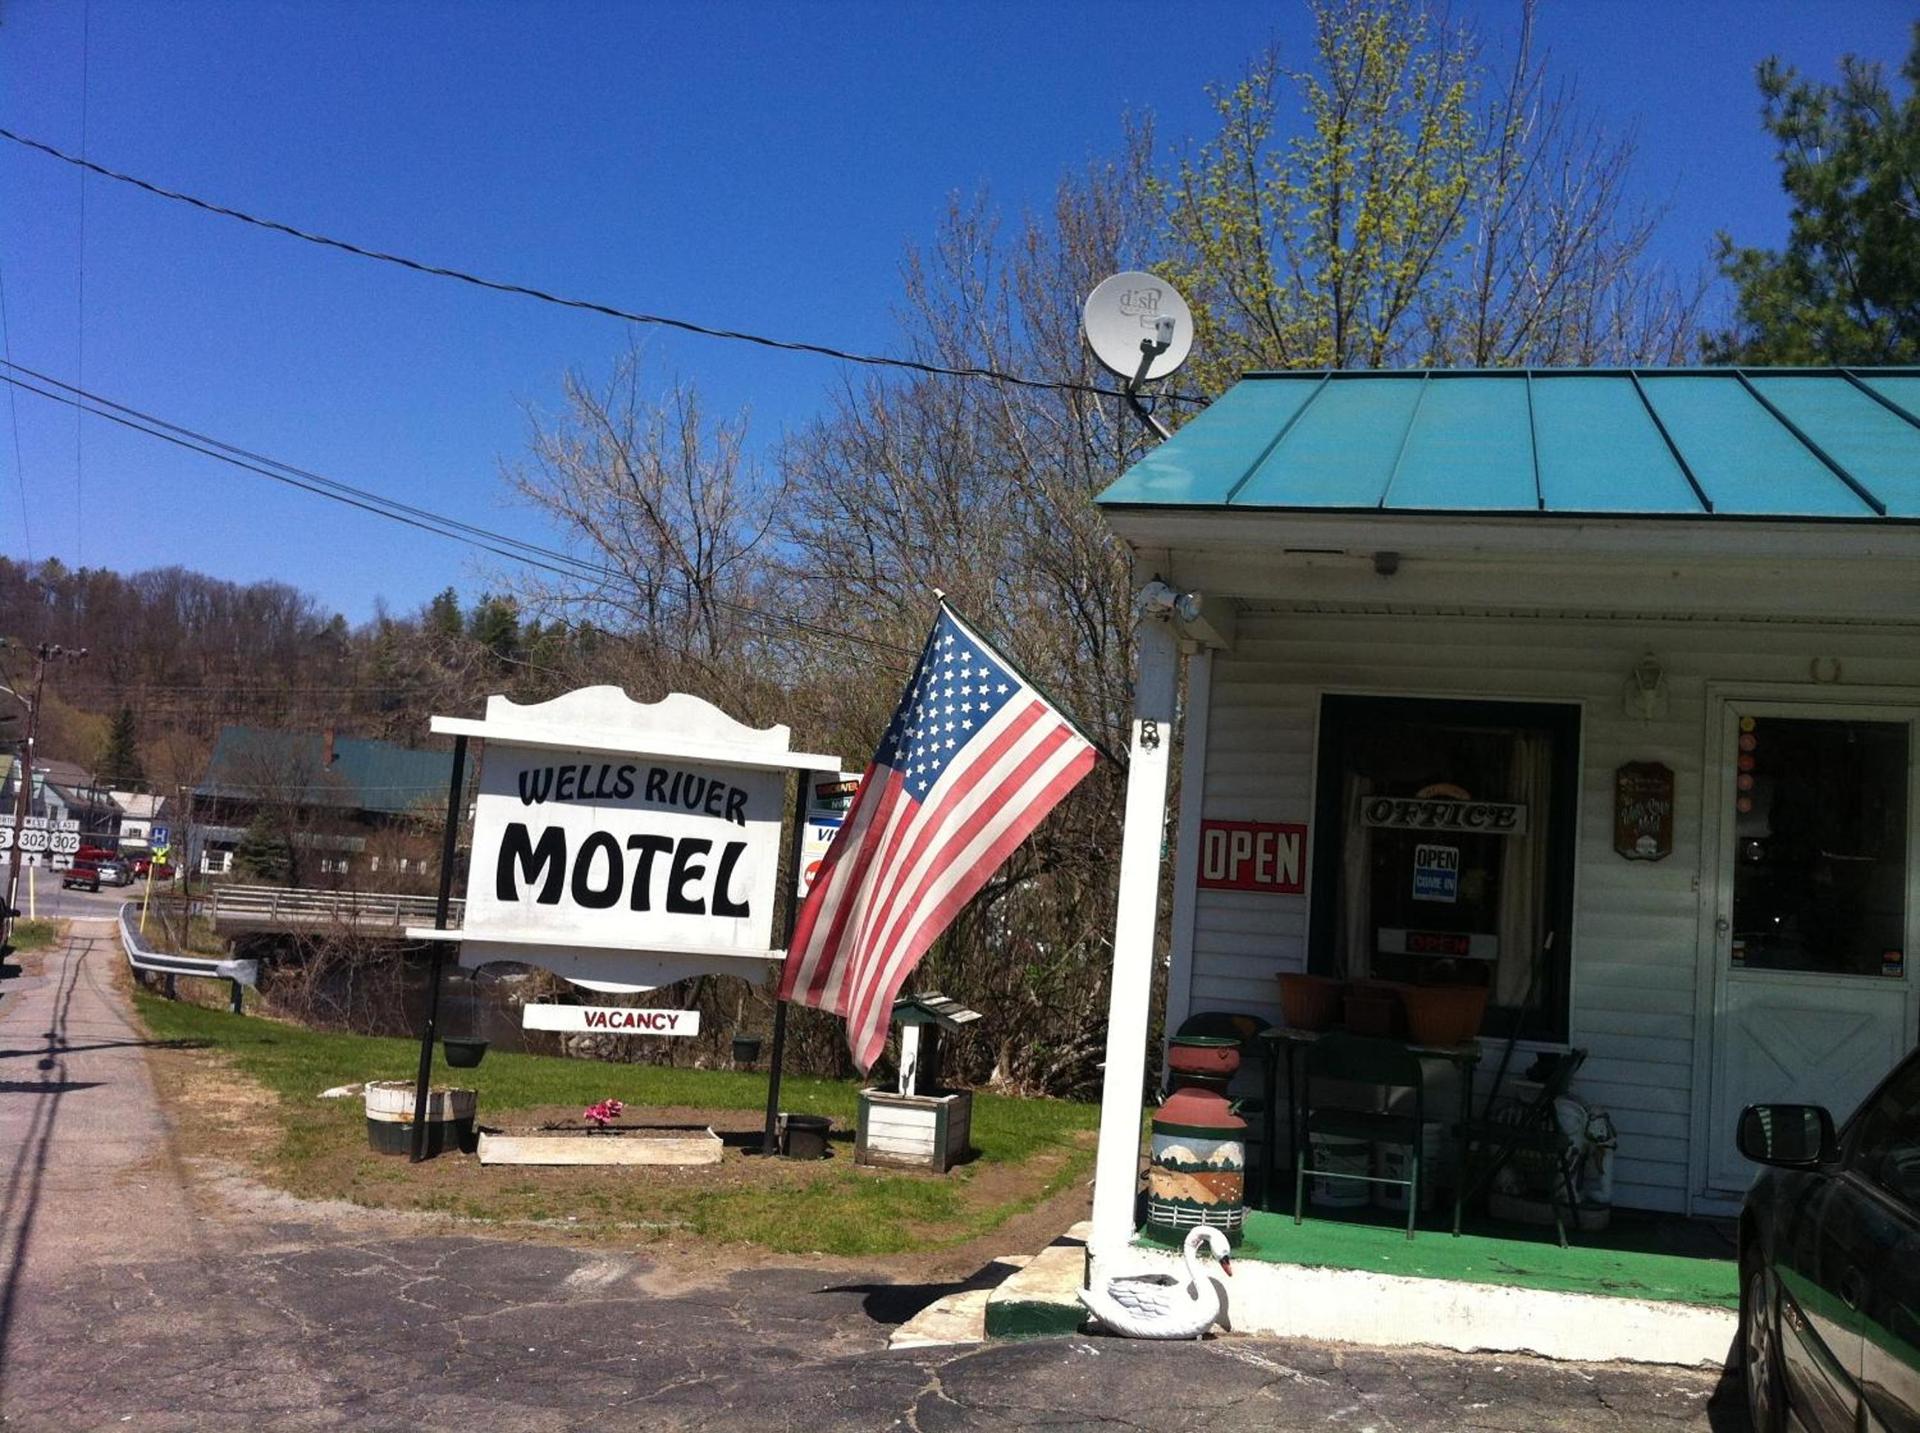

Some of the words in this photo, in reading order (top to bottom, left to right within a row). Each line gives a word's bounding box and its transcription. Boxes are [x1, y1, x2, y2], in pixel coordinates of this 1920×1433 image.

[1119, 289, 1159, 311] dish
[518, 764, 637, 806] WELLS
[645, 766, 748, 827] RIVER
[1366, 800, 1518, 830] OFFICE
[21, 833, 46, 847] 302
[53, 836, 77, 849] 302
[154, 829, 166, 842] H
[1203, 829, 1300, 885] OPEN
[1417, 847, 1457, 870] OPEN
[496, 822, 750, 918] MOTEL
[1416, 875, 1442, 889] COME
[584, 1010, 680, 1031] VACANCY
